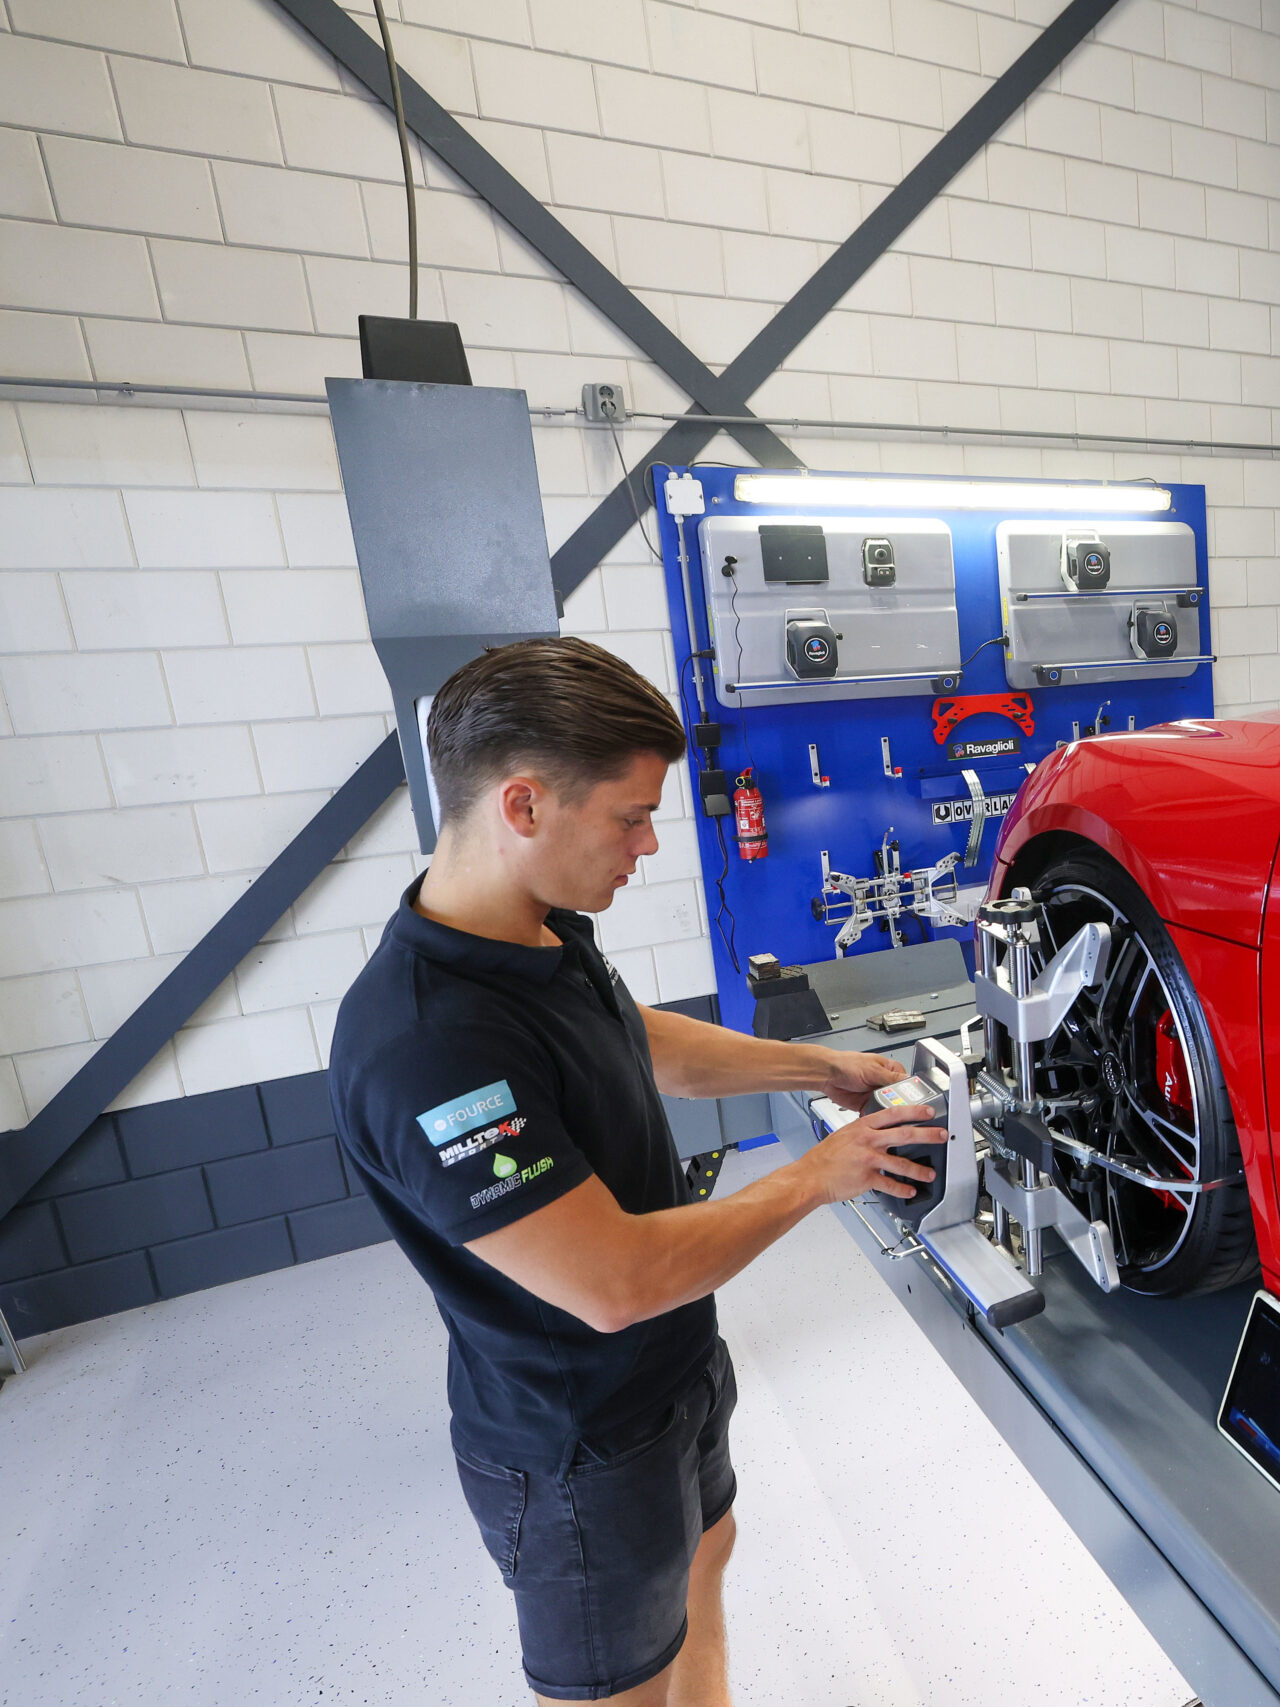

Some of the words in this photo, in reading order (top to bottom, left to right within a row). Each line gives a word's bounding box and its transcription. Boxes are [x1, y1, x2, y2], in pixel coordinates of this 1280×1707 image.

[966, 740, 1014, 755] Ravaglioli
[955, 799, 1016, 817] OVRLA
[446, 1095, 504, 1126] FOURCE
[447, 1138, 499, 1166] SPORT
[469, 1172, 522, 1209] DYNAMIC
[521, 1156, 554, 1183] FLUSH
